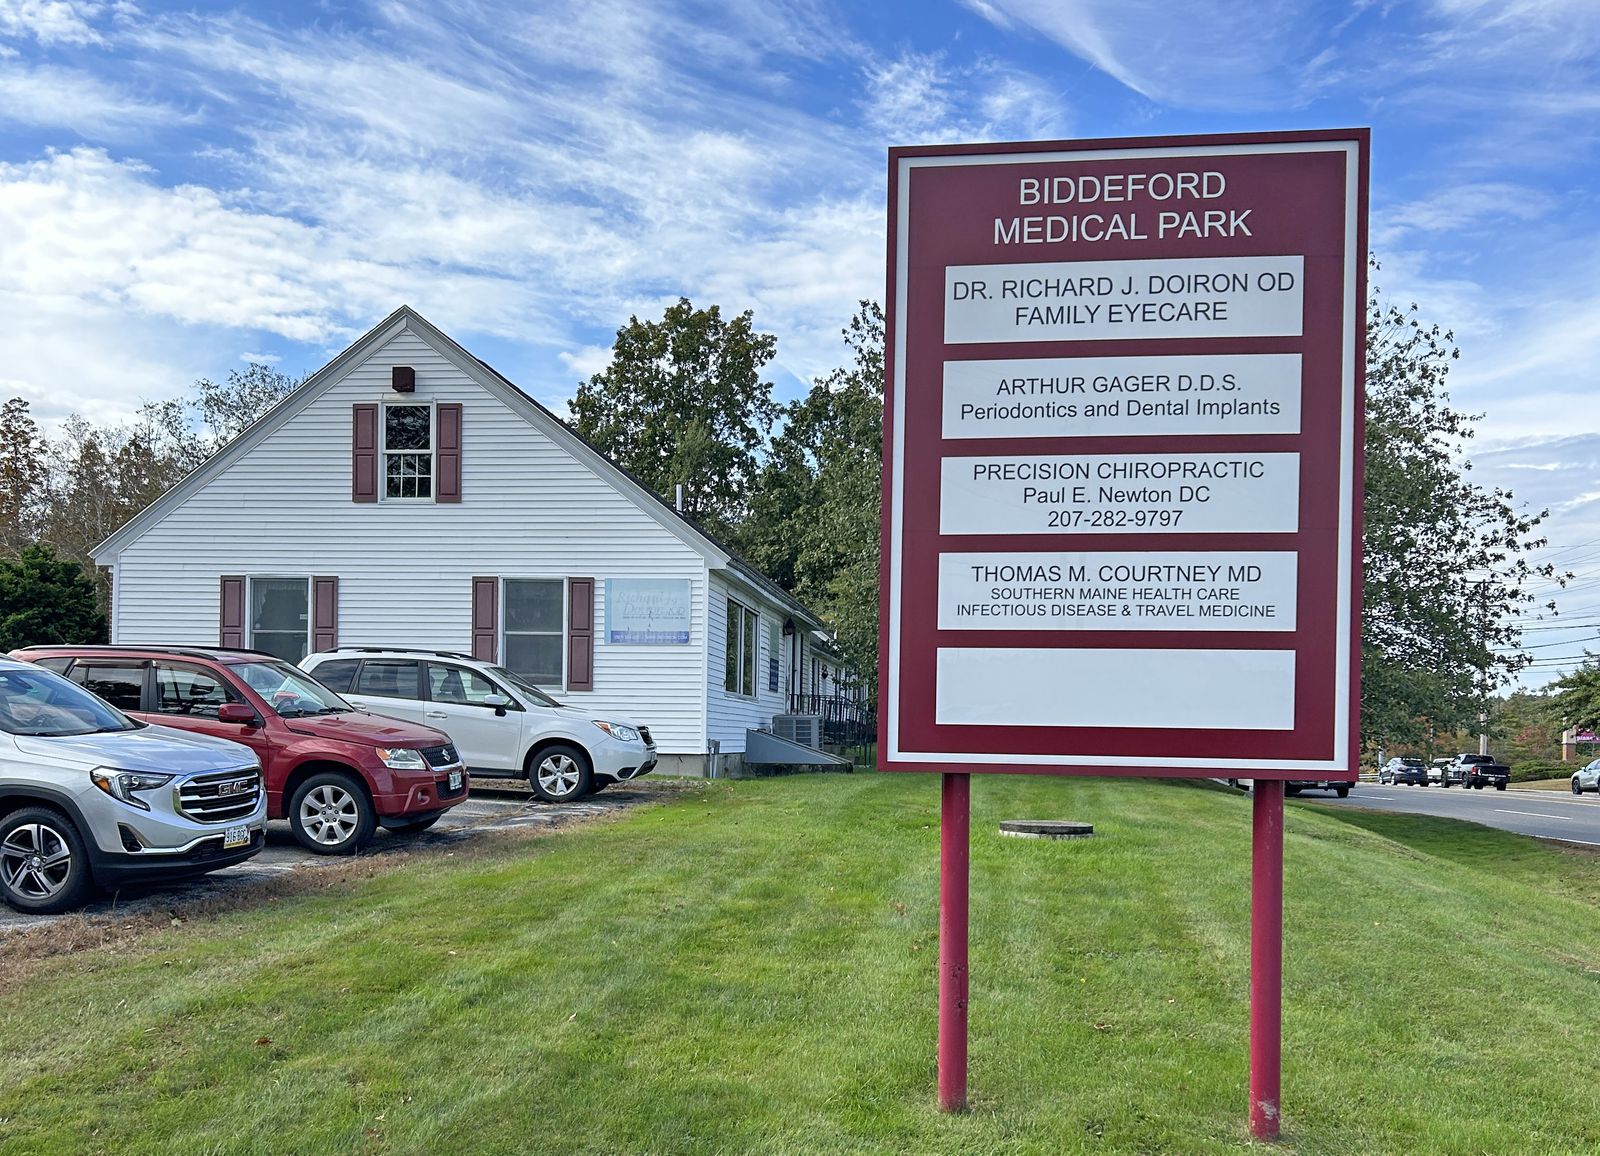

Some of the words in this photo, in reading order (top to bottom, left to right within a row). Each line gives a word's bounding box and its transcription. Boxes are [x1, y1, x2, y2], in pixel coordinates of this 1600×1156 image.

[1020, 173, 1226, 205] BIDDEFORD
[994, 213, 1148, 245] MEDICAL
[1158, 210, 1253, 239] PARK
[953, 281, 993, 301] DR.
[1002, 276, 1114, 299] RICHARD
[1120, 276, 1139, 296] J.
[1148, 272, 1249, 295] DOIRON
[1257, 272, 1295, 292] OD
[1015, 305, 1102, 326] FAMILY
[1108, 301, 1228, 324] EYECARE
[996, 376, 1086, 396] ARTHUR
[1092, 375, 1171, 394] GAGER
[1177, 373, 1242, 393] D.D.S.
[961, 402, 1078, 421] Periodontics
[1083, 400, 1120, 418] and
[1126, 399, 1190, 417] Dental
[1196, 398, 1281, 420] Implants
[973, 463, 1090, 481] PRECISION
[1096, 461, 1265, 480] CHIROPRACTIC
[1023, 486, 1065, 504] Paul
[1072, 486, 1092, 504] E.
[1098, 486, 1172, 504] Newton
[1179, 485, 1211, 503] DC
[1047, 509, 1184, 528] 207-282-9797
[971, 565, 1062, 583] THOMAS
[1068, 565, 1092, 582] M.
[1098, 565, 1222, 583] COURTNEY
[1228, 565, 1262, 583] MD
[990, 587, 1075, 600] SOUTHERN
[1079, 587, 1128, 600] MAINE
[1132, 587, 1192, 600] HEALTH
[1196, 587, 1240, 601] CARE
[957, 603, 1047, 617] INFECTIOUS
[1051, 603, 1117, 617] DISEASE
[1121, 604, 1132, 617] &
[1135, 604, 1195, 617] TRAVEL
[1199, 604, 1276, 618] MEDICINE
[218, 780, 248, 795] GMC
